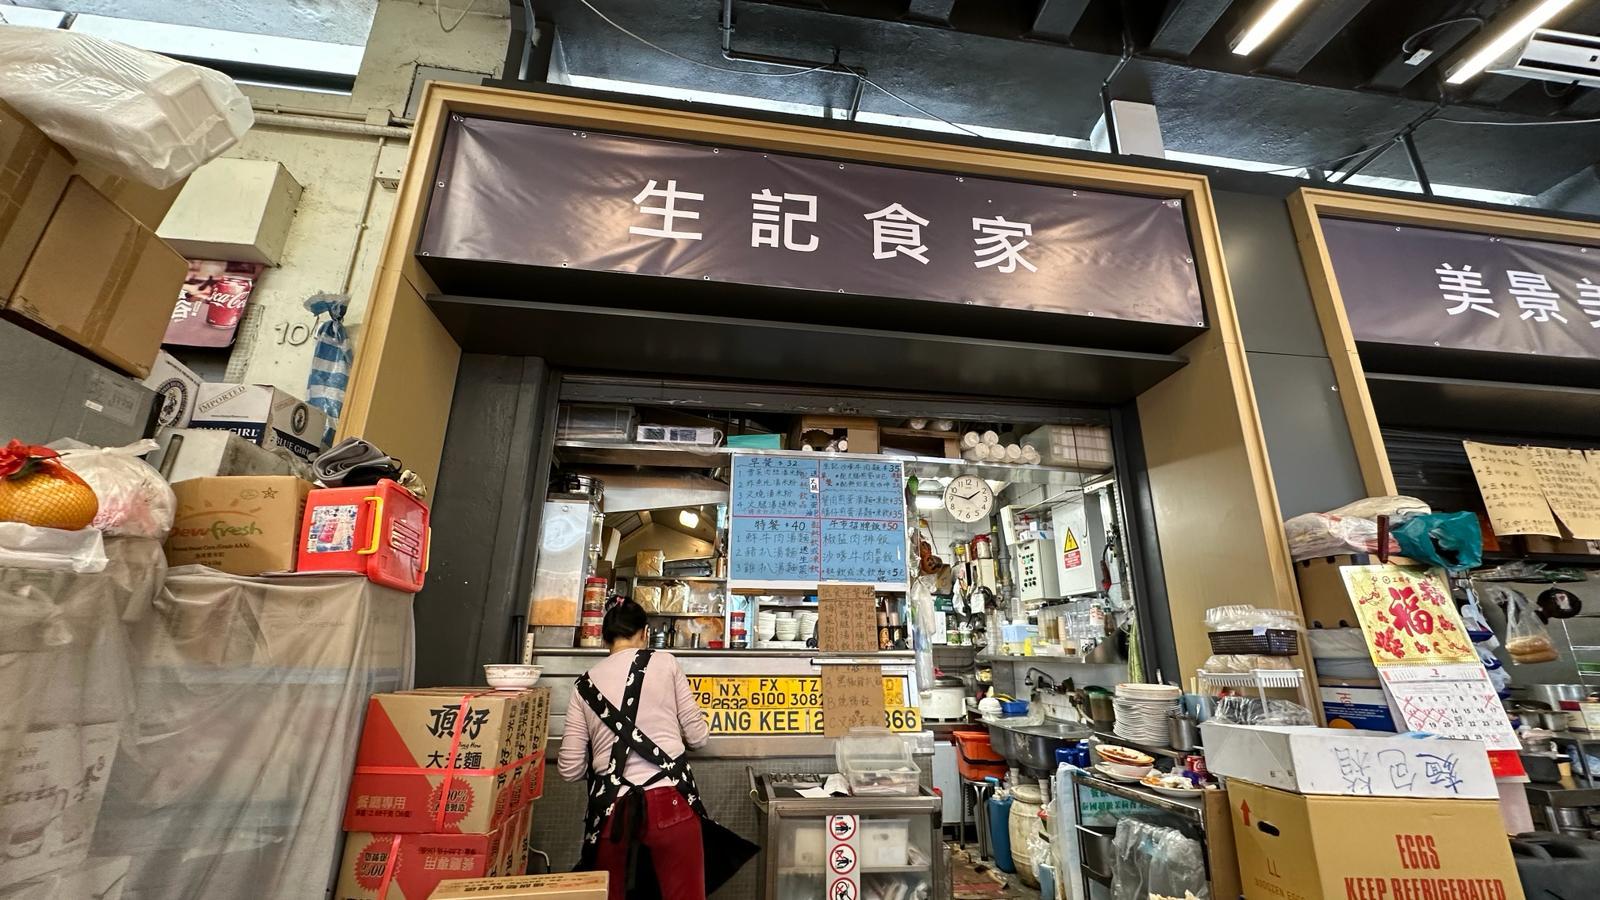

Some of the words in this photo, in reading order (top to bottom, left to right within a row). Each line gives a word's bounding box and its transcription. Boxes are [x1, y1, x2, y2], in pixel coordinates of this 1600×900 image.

[628, 179, 1039, 274] 生記食家
[199, 385, 246, 413] IMPORTED
[276, 436, 295, 450] BLUE
[754, 519, 781, 531] 特餐
[1388, 586, 1434, 637] 福
[720, 683, 740, 696] NX
[760, 679, 778, 691] FX
[798, 680, 819, 691] TZ
[713, 698, 748, 709] 2632
[751, 693, 785, 705] 6100
[426, 705, 490, 740] 頂好
[760, 711, 799, 731] KEE
[426, 751, 482, 769] 大光麵
[439, 790, 469, 802] 00%
[1395, 834, 1441, 870] EGGS
[1266, 856, 1281, 879] LL
[1344, 877, 1387, 900] KEEP
[1391, 877, 1507, 900] REFRIGERATED
